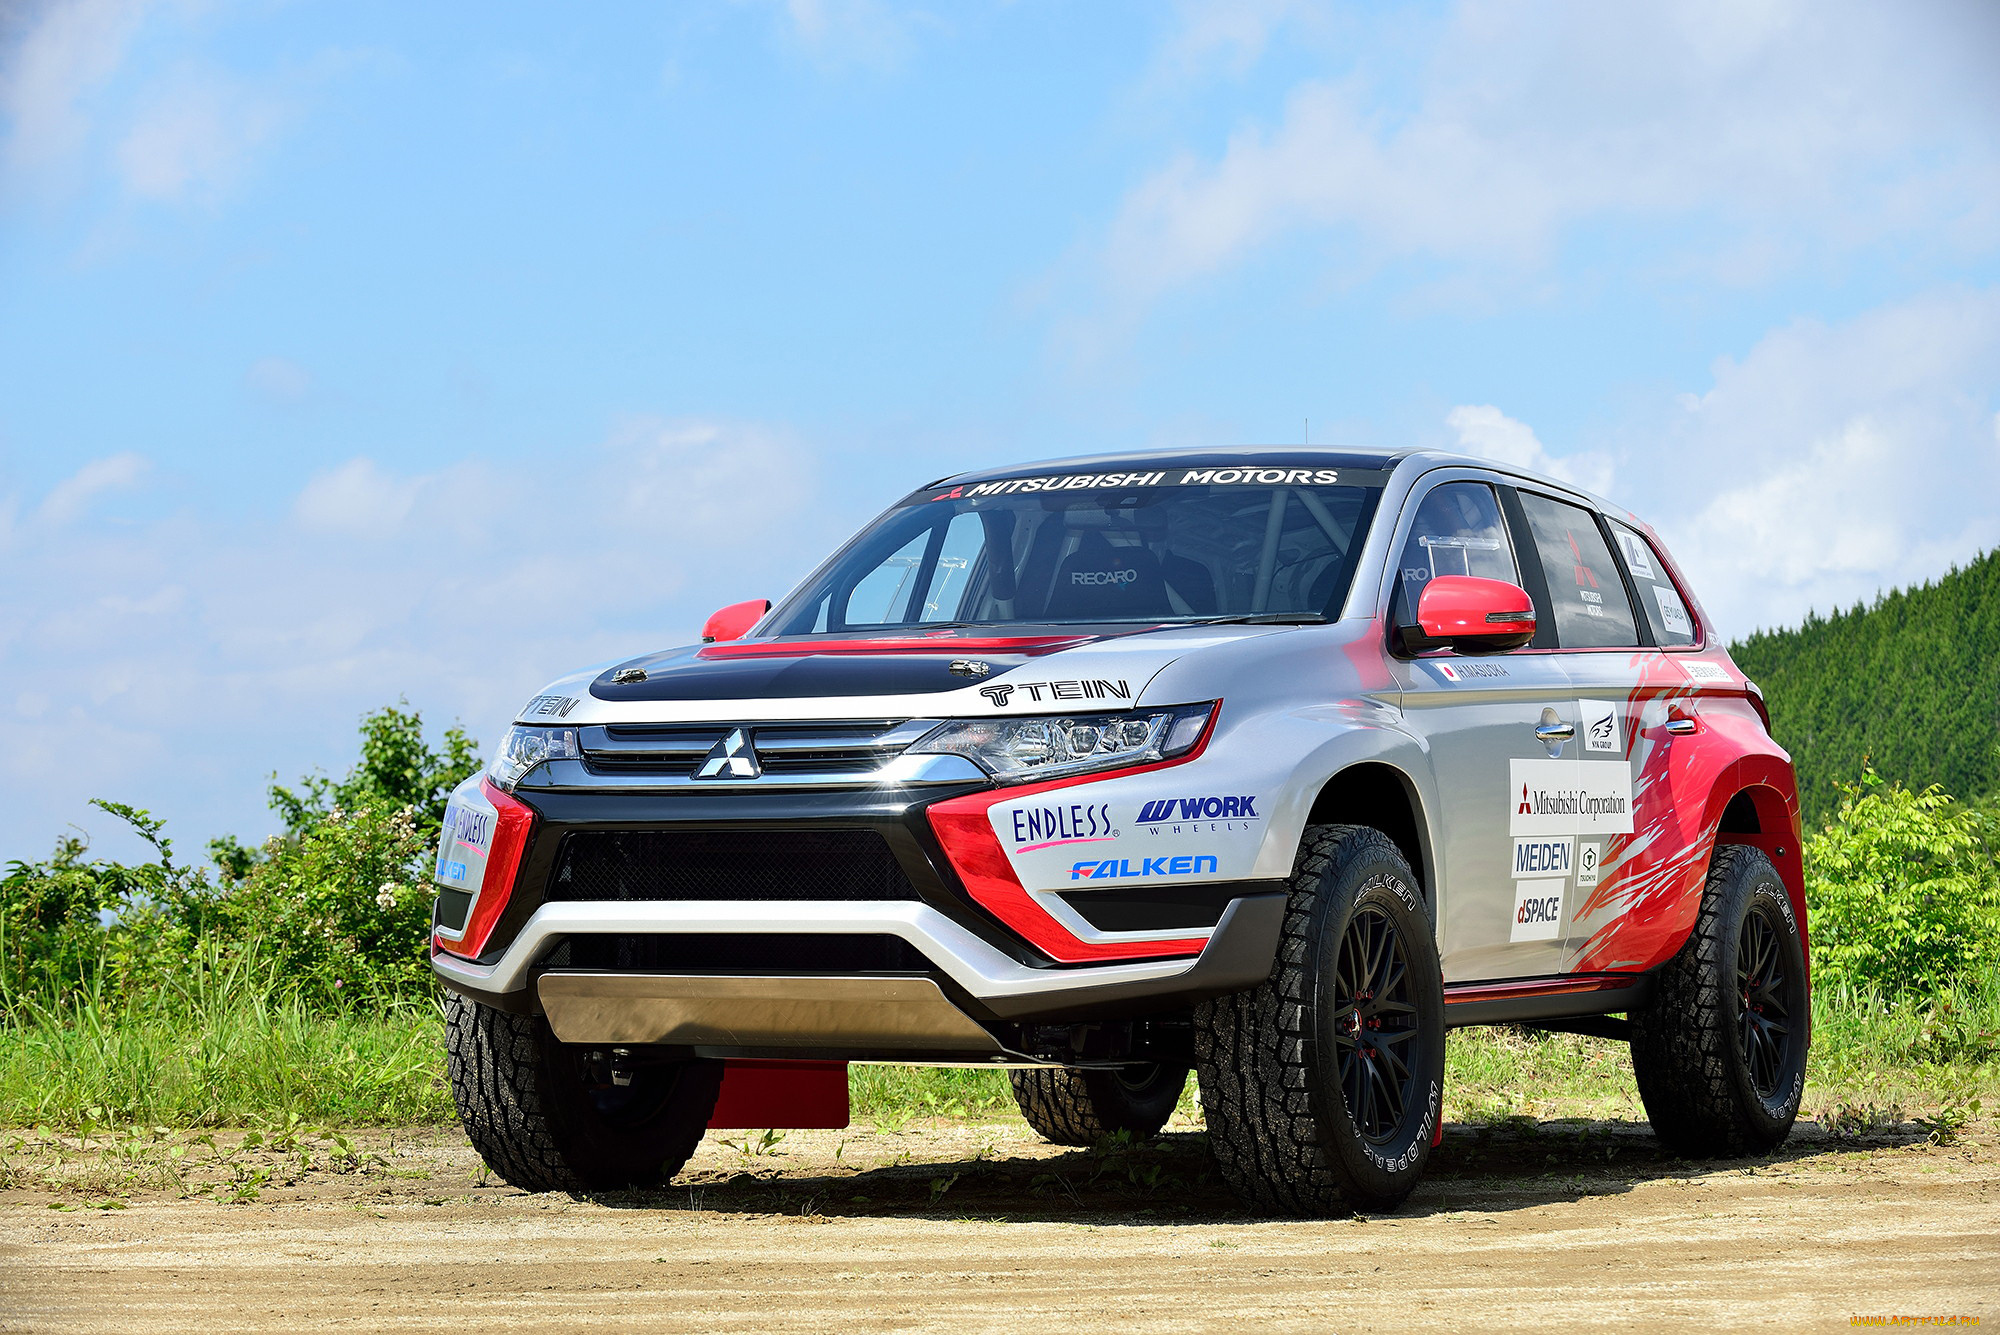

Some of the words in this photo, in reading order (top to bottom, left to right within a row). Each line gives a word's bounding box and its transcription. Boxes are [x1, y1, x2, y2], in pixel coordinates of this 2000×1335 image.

[964, 471, 1166, 497] MITSUBISHI
[1179, 468, 1338, 485] MOTORS
[1071, 569, 1137, 586] RECARO
[1017, 679, 1132, 702] TEIN
[1533, 790, 1578, 815] Mitsubishi
[1579, 790, 1626, 821] Corporation
[457, 808, 488, 845] ENDLESS
[1012, 803, 1113, 843] ENDLESS
[1149, 822, 1250, 836] WHEELS
[1066, 855, 1218, 881] FALKEN
[1516, 842, 1570, 872] MEIDEN
[1517, 897, 1559, 924] dSPACE
